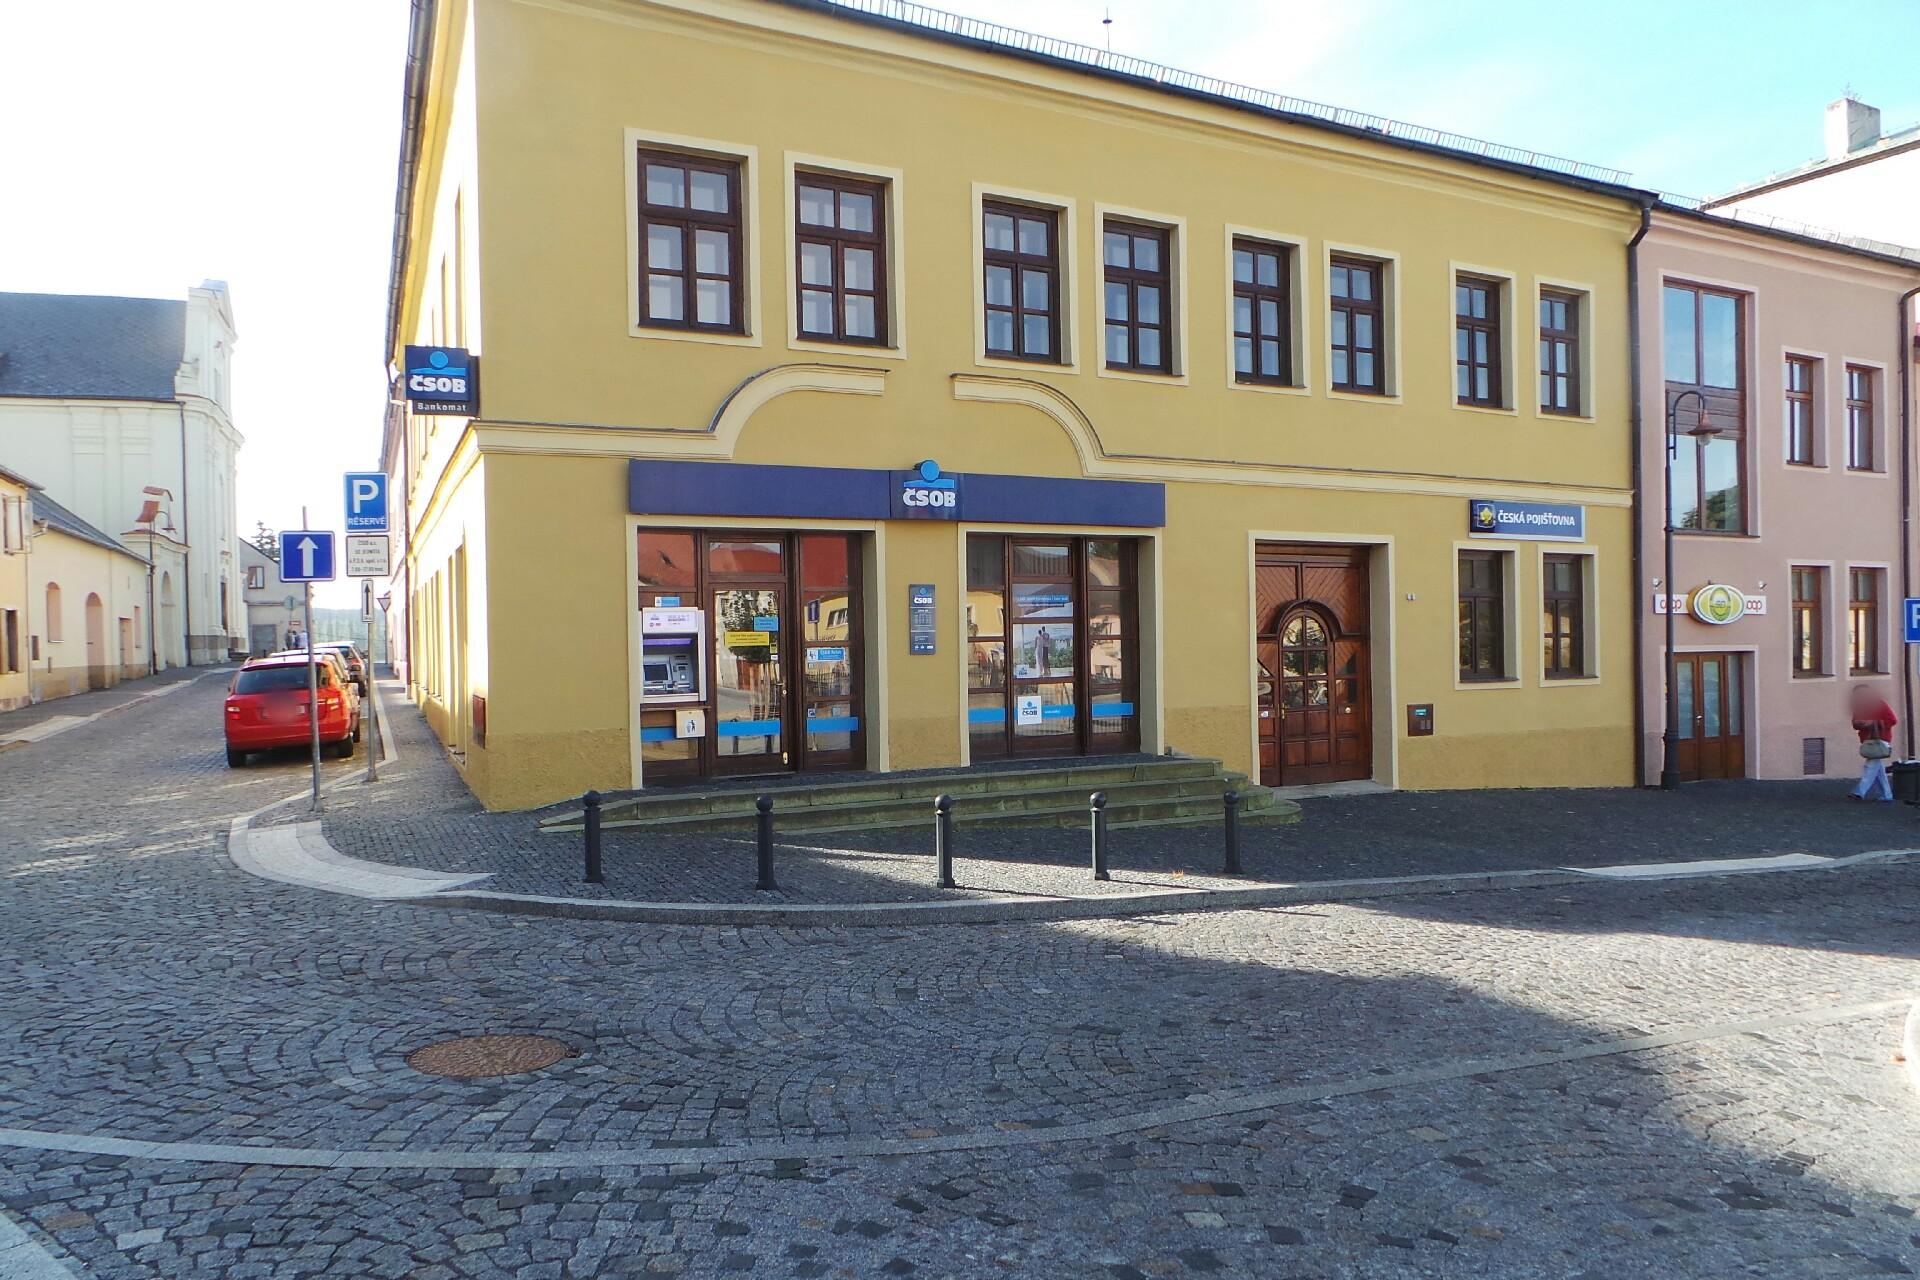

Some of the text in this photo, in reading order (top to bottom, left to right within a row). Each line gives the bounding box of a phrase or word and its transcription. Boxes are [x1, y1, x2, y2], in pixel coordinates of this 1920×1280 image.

[410, 374, 466, 394] ČSOB
[417, 402, 466, 412] Bankomat
[353, 479, 379, 514] P
[902, 487, 956, 508] ČSOB
[348, 515, 387, 526] RÉSERVÉ
[1498, 509, 1576, 526] ČESKÁ POJIŠŤOVNA
